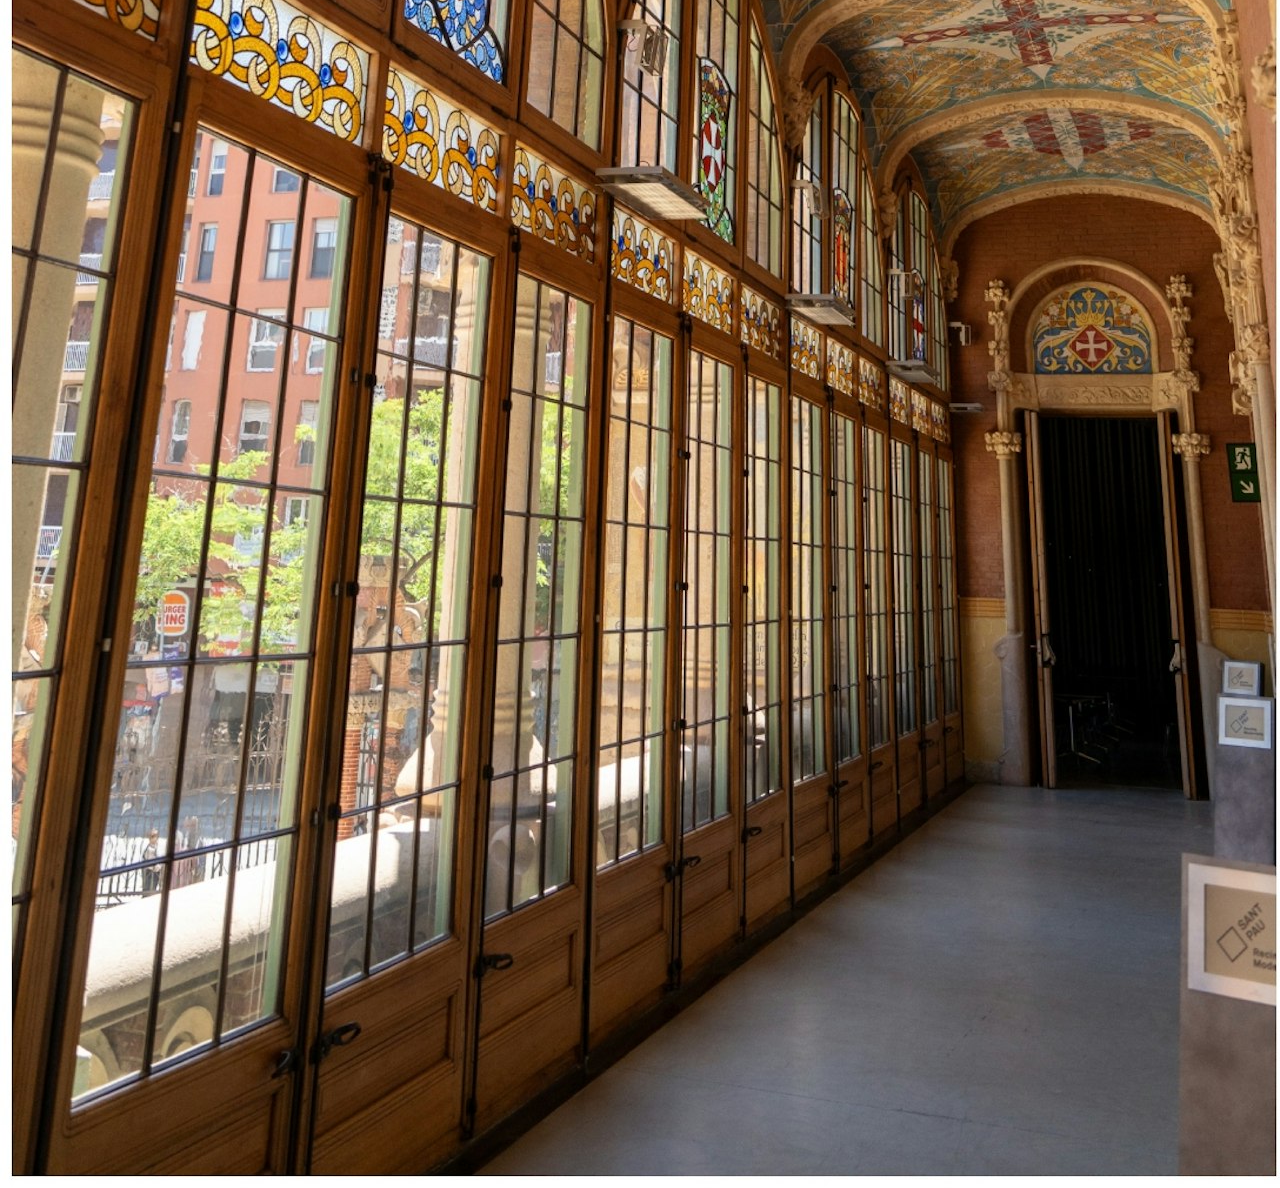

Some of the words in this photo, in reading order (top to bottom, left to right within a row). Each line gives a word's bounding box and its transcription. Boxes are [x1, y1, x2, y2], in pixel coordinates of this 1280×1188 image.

[162, 605, 187, 613] URGER
[1238, 902, 1263, 931] SANT
[1246, 919, 1266, 941] PAU
